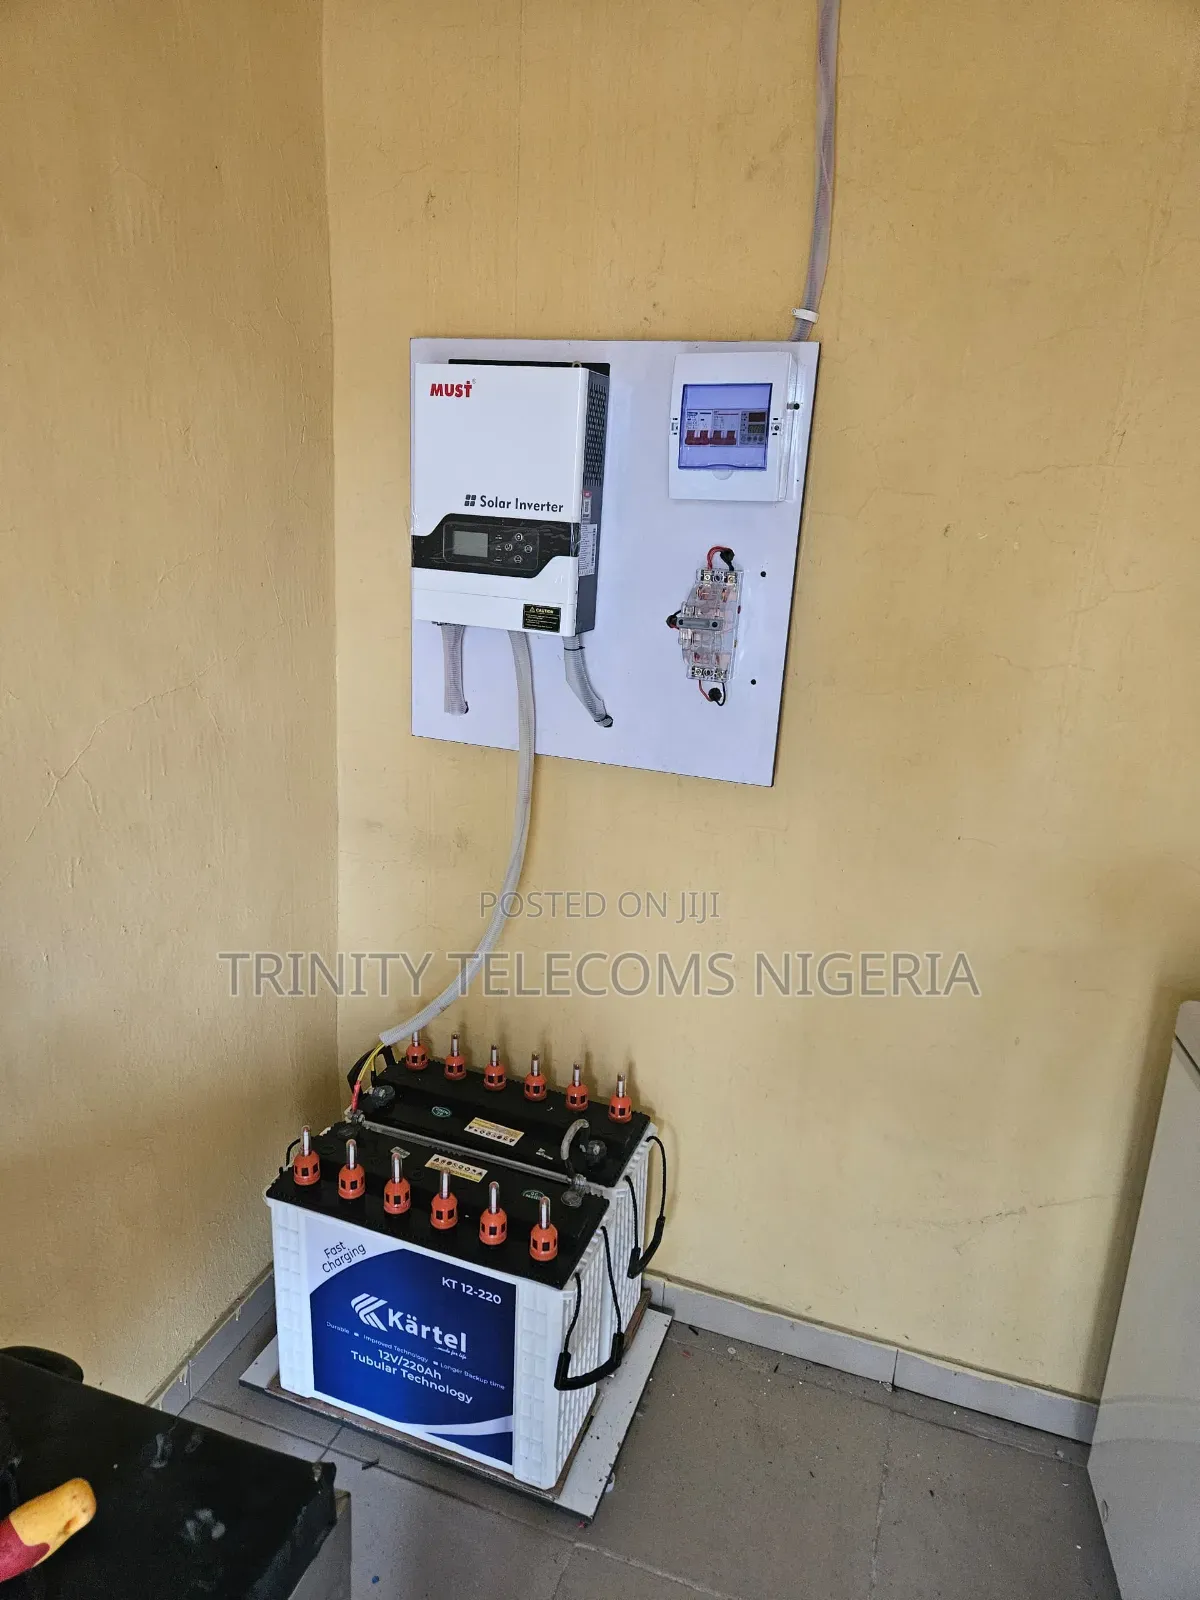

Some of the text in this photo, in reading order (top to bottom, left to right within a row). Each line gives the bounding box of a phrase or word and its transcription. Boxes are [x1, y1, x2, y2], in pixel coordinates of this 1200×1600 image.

[430, 380, 472, 397] MUST
[480, 494, 563, 512] Solar Inverter
[322, 1244, 366, 1273] Charging
[323, 1241, 347, 1259] Fast
[442, 1276, 502, 1304] KT 12-220
[388, 1307, 467, 1353] Kärtel
[326, 1321, 350, 1335] Durable
[363, 1334, 393, 1350] Improved
[394, 1345, 429, 1363] Technology
[440, 1362, 463, 1374] Longer
[464, 1371, 489, 1385] Backup
[377, 1349, 442, 1380] 12V/220Ah
[350, 1350, 473, 1404] Tubular Technology
